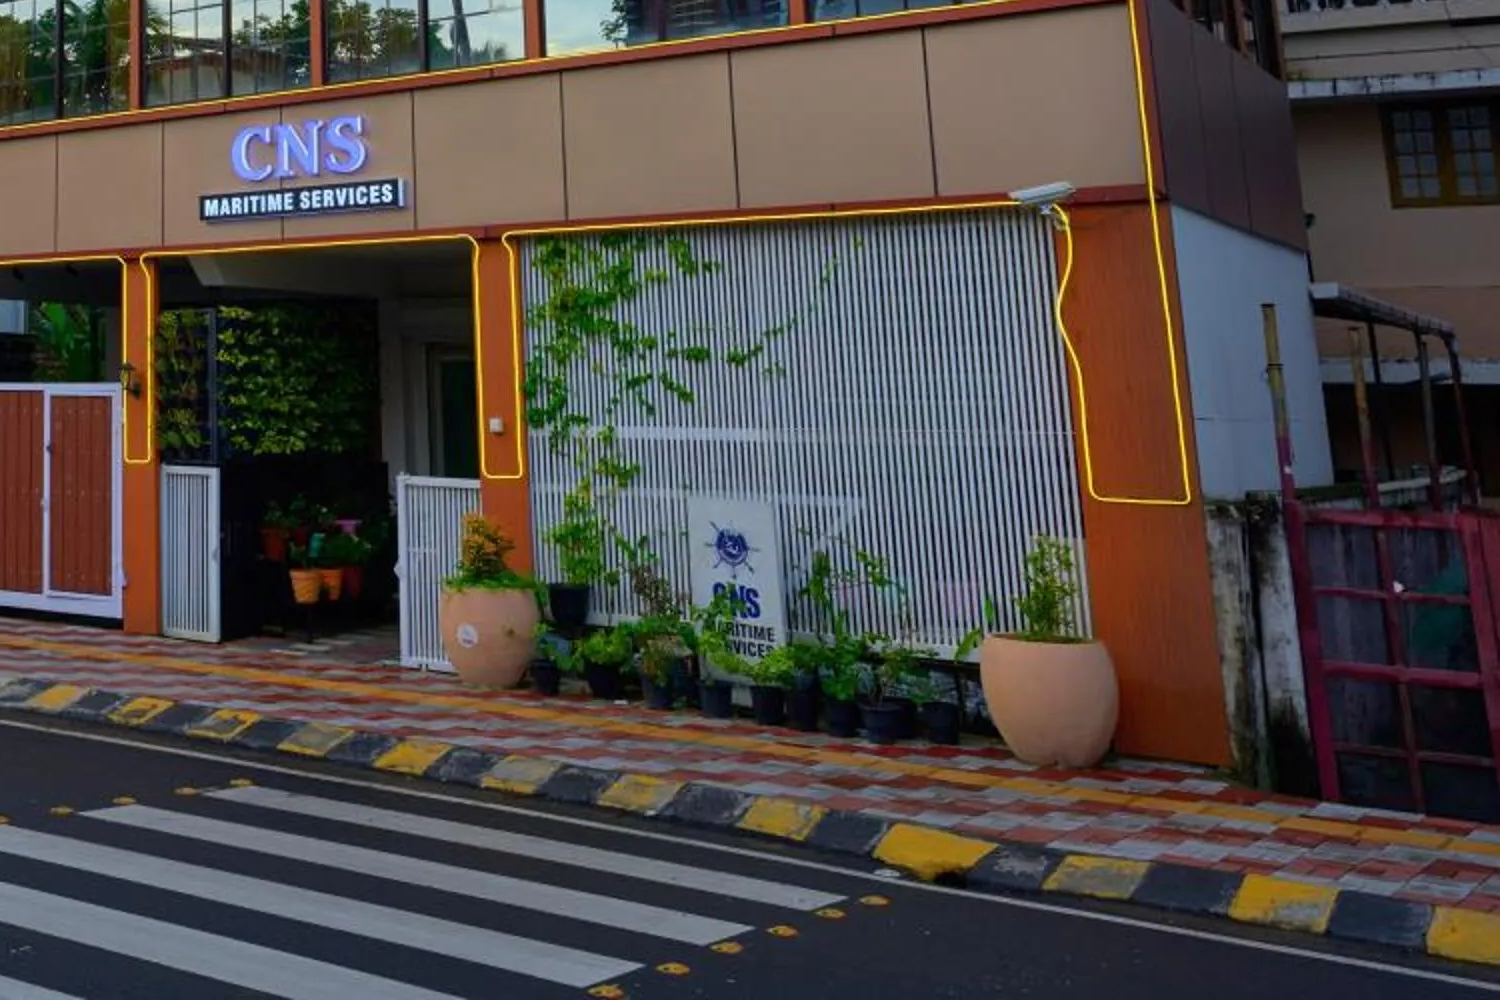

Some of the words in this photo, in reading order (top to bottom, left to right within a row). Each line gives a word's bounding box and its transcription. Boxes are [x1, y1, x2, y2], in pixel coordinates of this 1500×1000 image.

[231, 115, 368, 181] CNS
[204, 193, 295, 217] MARITIME
[300, 184, 393, 209] SERVICES
